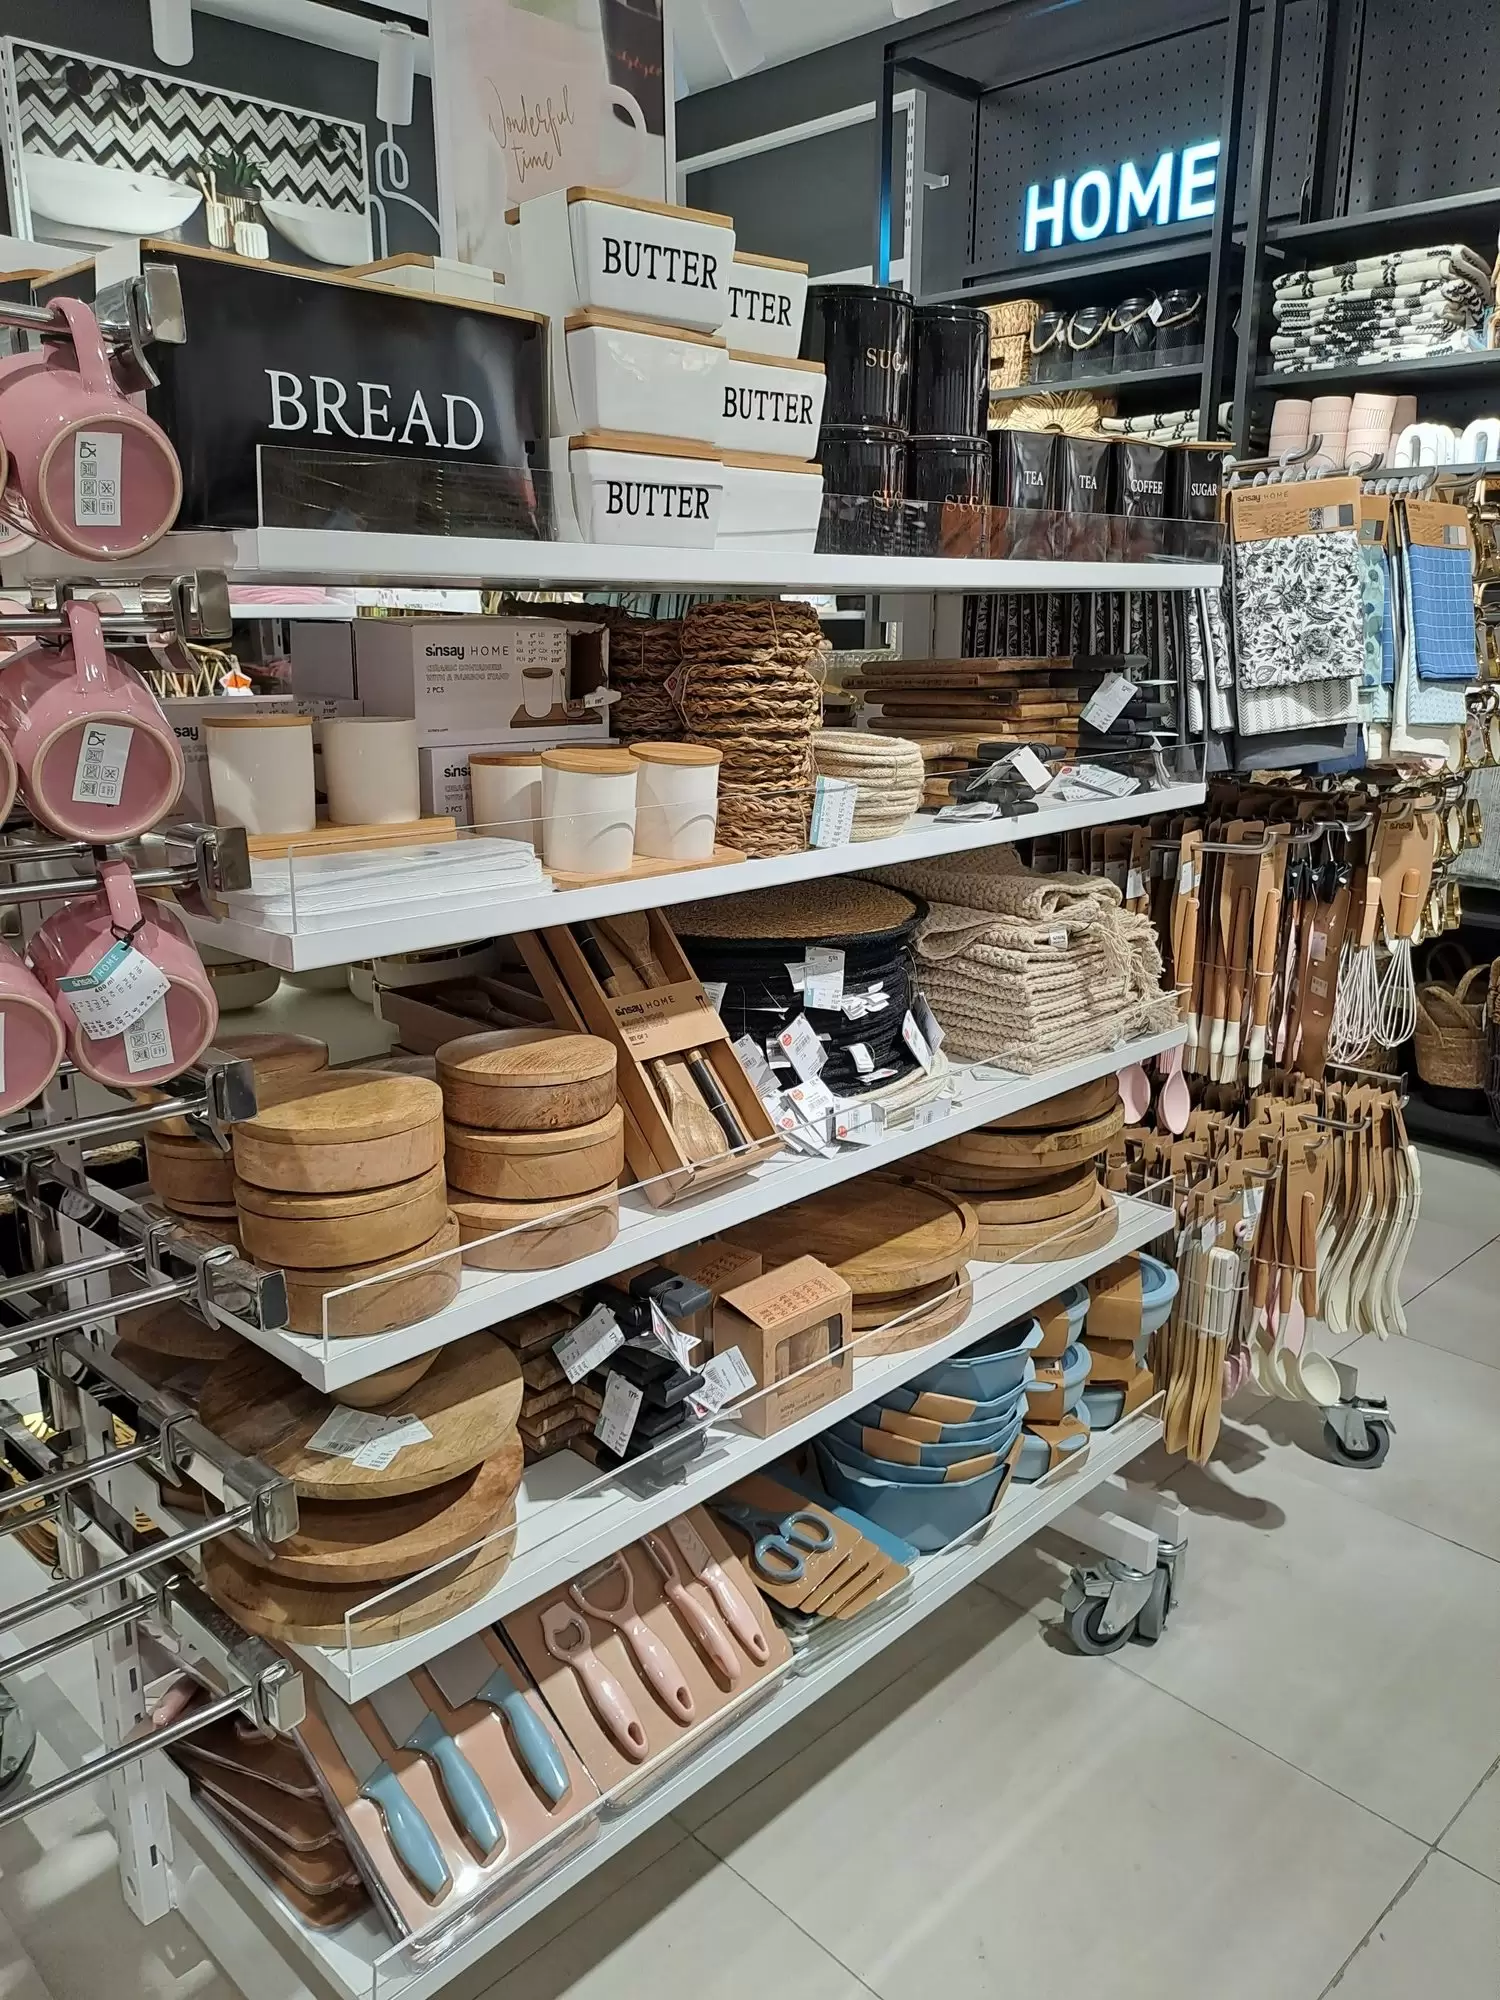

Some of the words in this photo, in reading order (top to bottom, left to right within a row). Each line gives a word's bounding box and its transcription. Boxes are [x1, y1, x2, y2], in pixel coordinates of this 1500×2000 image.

[511, 140, 554, 183] time
[1024, 140, 1221, 253] HOME
[602, 237, 718, 290] BUTTER
[728, 286, 792, 327] TTER
[264, 369, 485, 451] BREAD
[722, 386, 813, 425] BUTTER
[1024, 470, 1044, 486] TEA
[1079, 474, 1097, 490] TEA
[1130, 479, 1163, 495] COFFEE
[1191, 482, 1218, 497] SUGAR
[606, 480, 710, 520] BUTTER
[425, 643, 465, 661] sinsay
[470, 646, 510, 657] HOME
[173, 726, 199, 741] say
[96, 952, 120, 978] HOME
[615, 1003, 645, 1016] sinsay
[645, 995, 676, 1009] HOME
